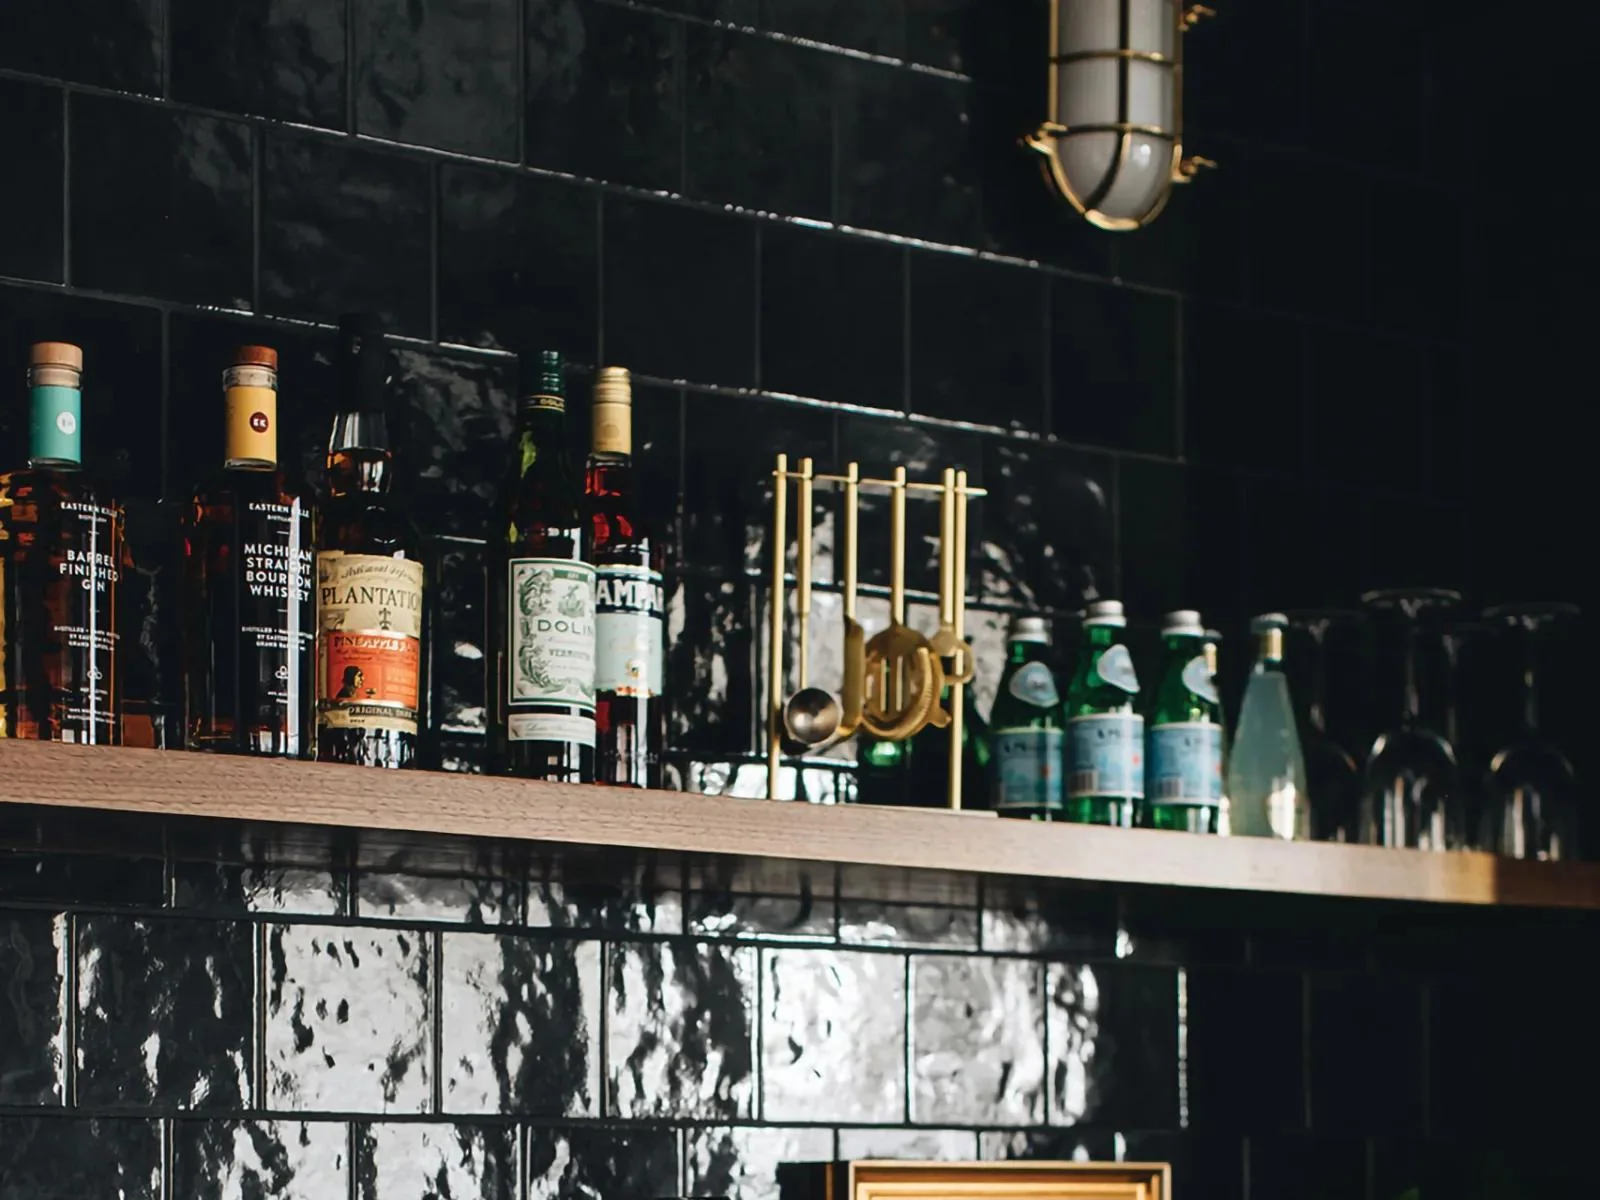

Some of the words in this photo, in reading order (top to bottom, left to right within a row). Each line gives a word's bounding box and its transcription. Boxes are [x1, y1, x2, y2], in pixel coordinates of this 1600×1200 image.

[60, 501, 99, 513] EASTERN
[248, 503, 289, 513] EASTERN
[67, 549, 115, 568] BARREL
[60, 563, 119, 582] FINISHED
[81, 579, 106, 592] GN
[321, 586, 418, 611] PLANTATIO
[597, 579, 664, 612] AMPA
